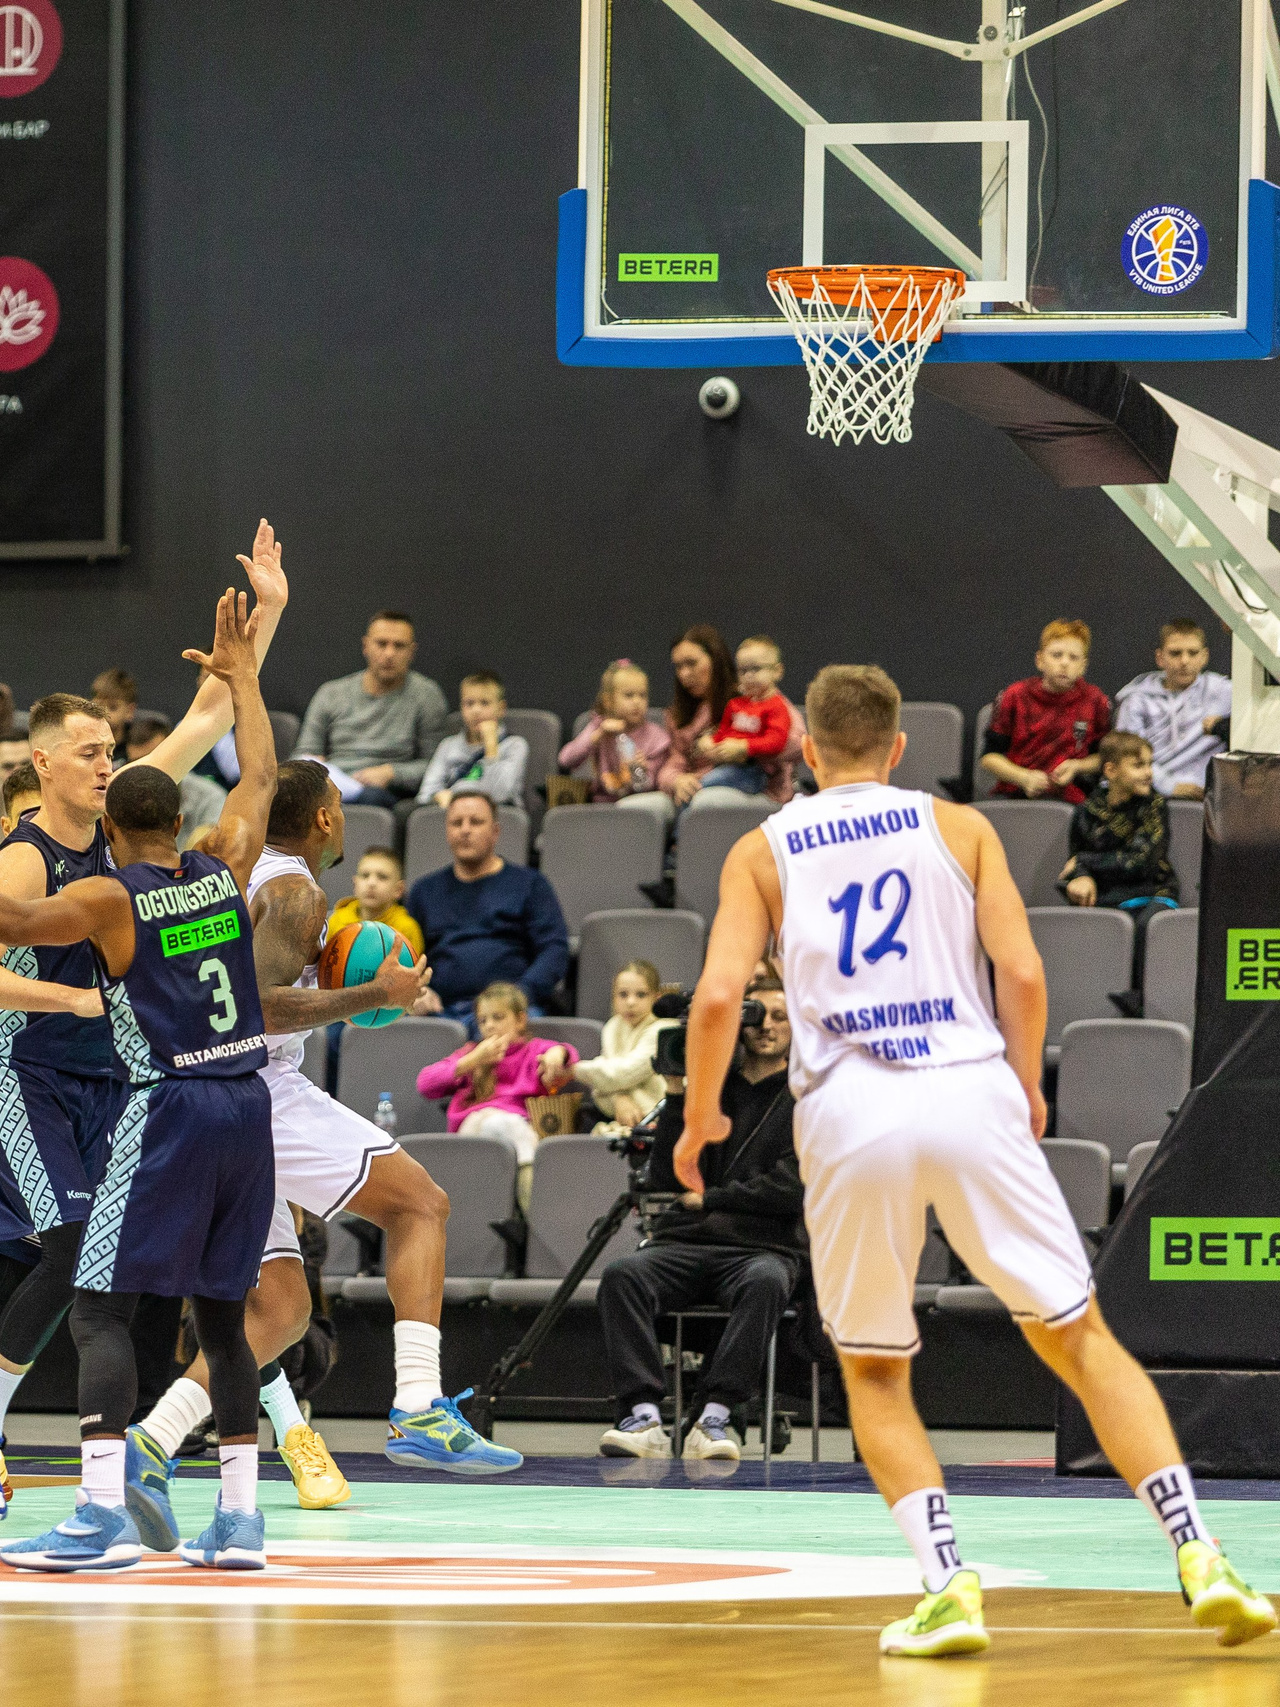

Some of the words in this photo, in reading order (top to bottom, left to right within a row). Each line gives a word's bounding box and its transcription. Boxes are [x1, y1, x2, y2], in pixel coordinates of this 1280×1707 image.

[1126, 207, 1160, 237] ЕДИНАЯ
[1160, 206, 1185, 218] ЛИГА
[1184, 214, 1201, 231] ВТБ
[1128, 268, 1144, 286] VTB
[1142, 283, 1174, 295] UNITED
[1174, 263, 1204, 292] LEAGUE
[786, 807, 920, 855] BELIANKOU
[135, 869, 239, 922] OGUNGBEMI
[828, 868, 912, 978] 12
[198, 957, 238, 1033] 3
[173, 1032, 267, 1068] BELTAMOZHSERV
[66, 1190, 92, 1201] Kemp
